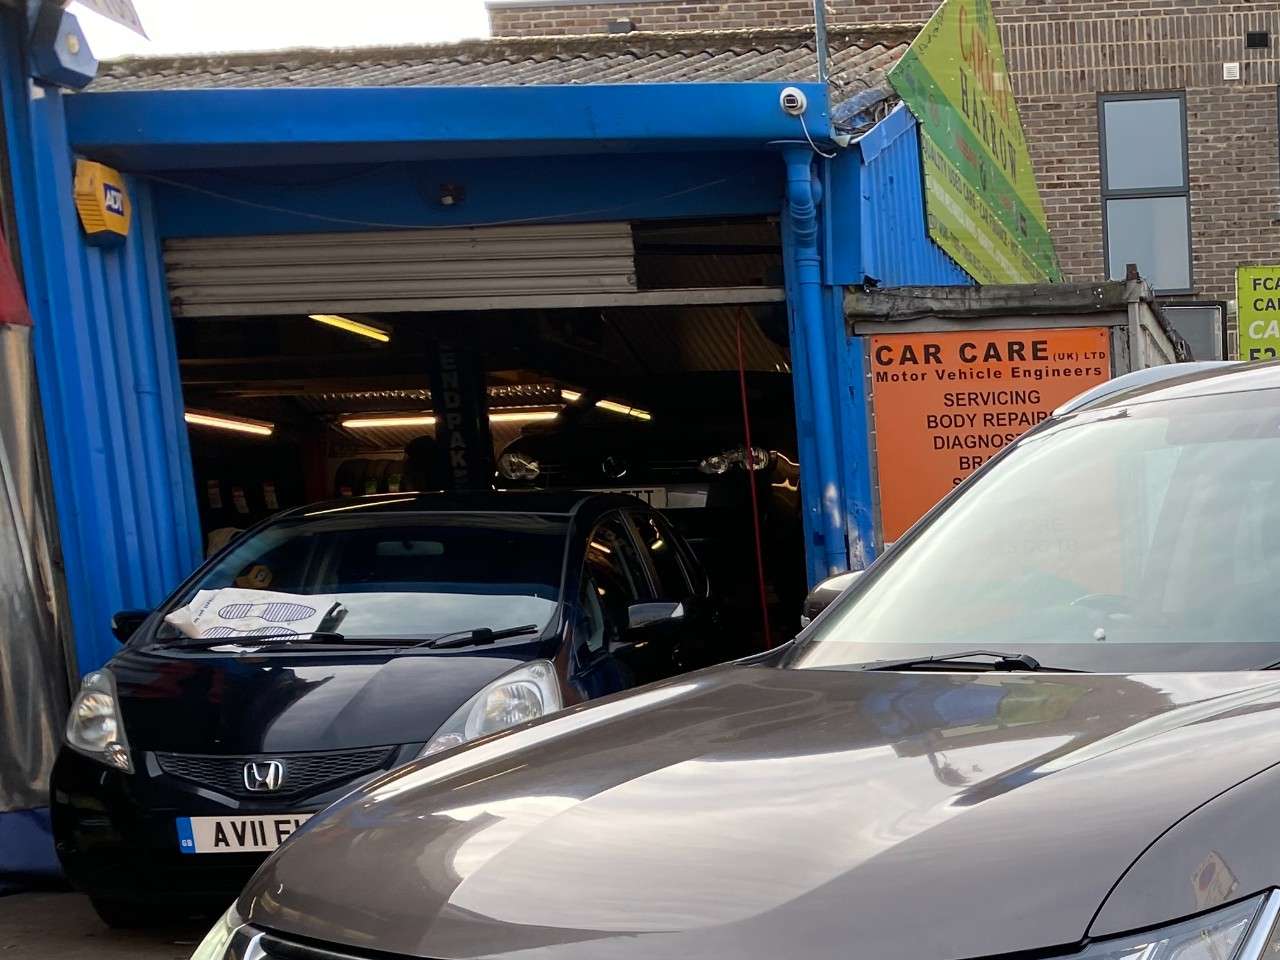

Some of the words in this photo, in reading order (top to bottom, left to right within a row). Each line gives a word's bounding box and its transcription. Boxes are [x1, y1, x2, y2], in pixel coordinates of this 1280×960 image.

[959, 66, 1017, 184] HARROW
[104, 188, 123, 213] ADT
[874, 343, 944, 366] CAR
[958, 340, 1050, 363] CARE
[1052, 351, 1080, 362] (UK)
[1083, 350, 1107, 361] LTD
[875, 369, 928, 383] Motor
[936, 366, 1002, 381] Vehicle
[1010, 364, 1103, 381] Engineers
[943, 389, 1041, 408] SERVICING
[926, 412, 977, 430] BODY
[933, 432, 1023, 450] DIAGNOS
[213, 820, 268, 848] AV11
